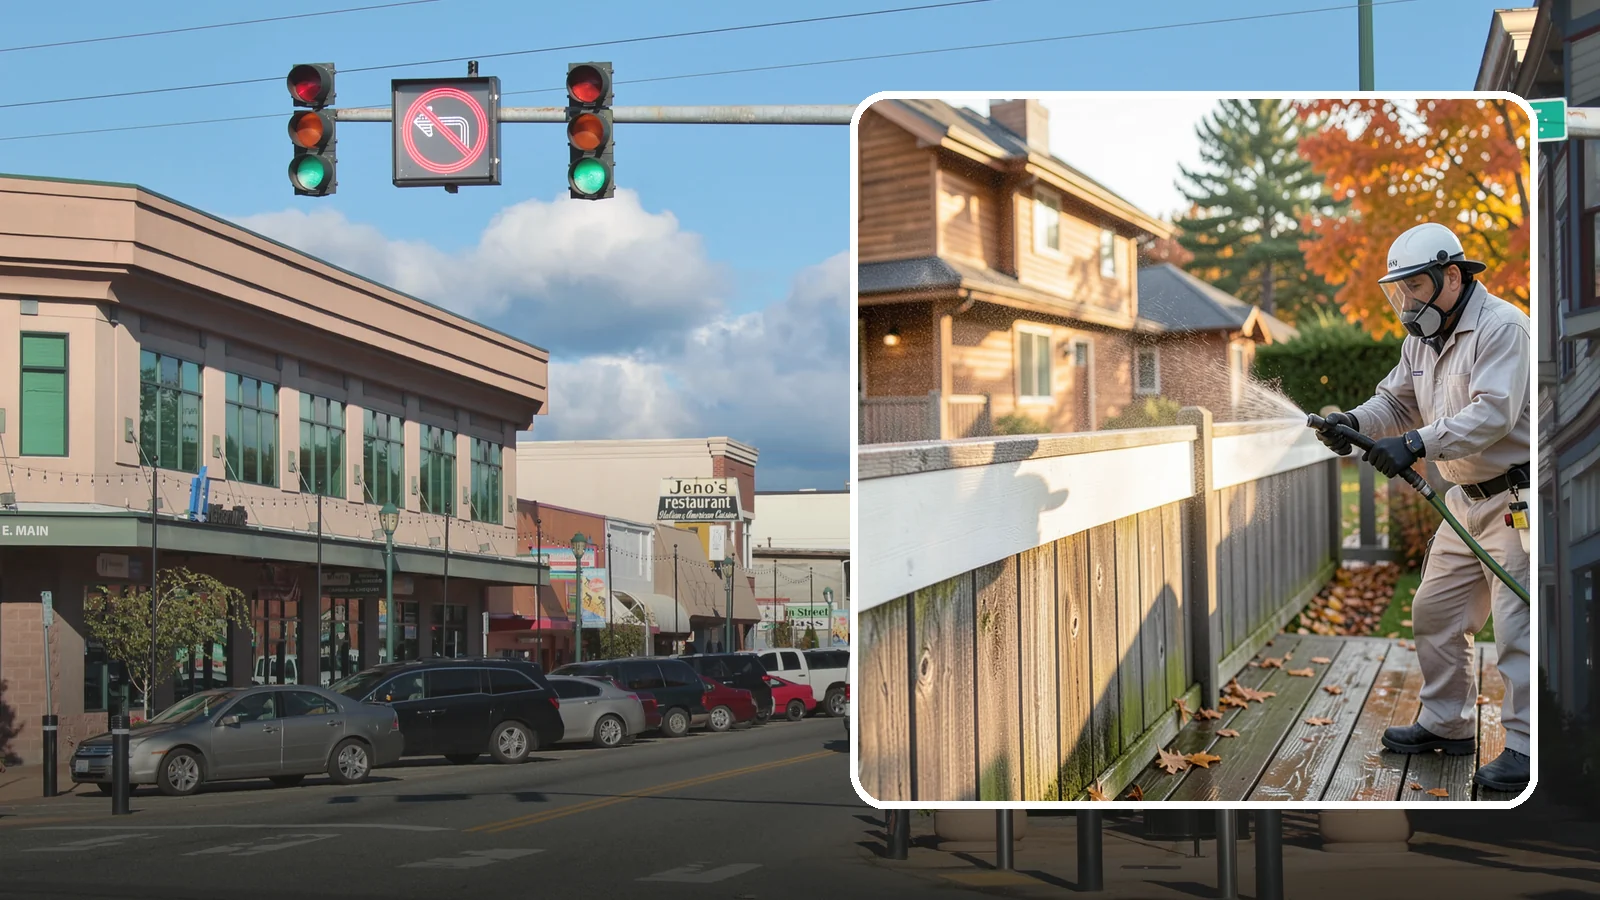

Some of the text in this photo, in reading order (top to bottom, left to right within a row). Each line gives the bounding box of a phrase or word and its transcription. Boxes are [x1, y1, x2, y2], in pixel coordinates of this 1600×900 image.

[670, 480, 728, 494] Jeno's
[665, 497, 731, 508] restaurant
[686, 510, 714, 519] American
[715, 510, 737, 519] Cuisine
[2, 525, 49, 536] E. MAIN
[797, 607, 828, 617] Street
[790, 619, 824, 627] lass
